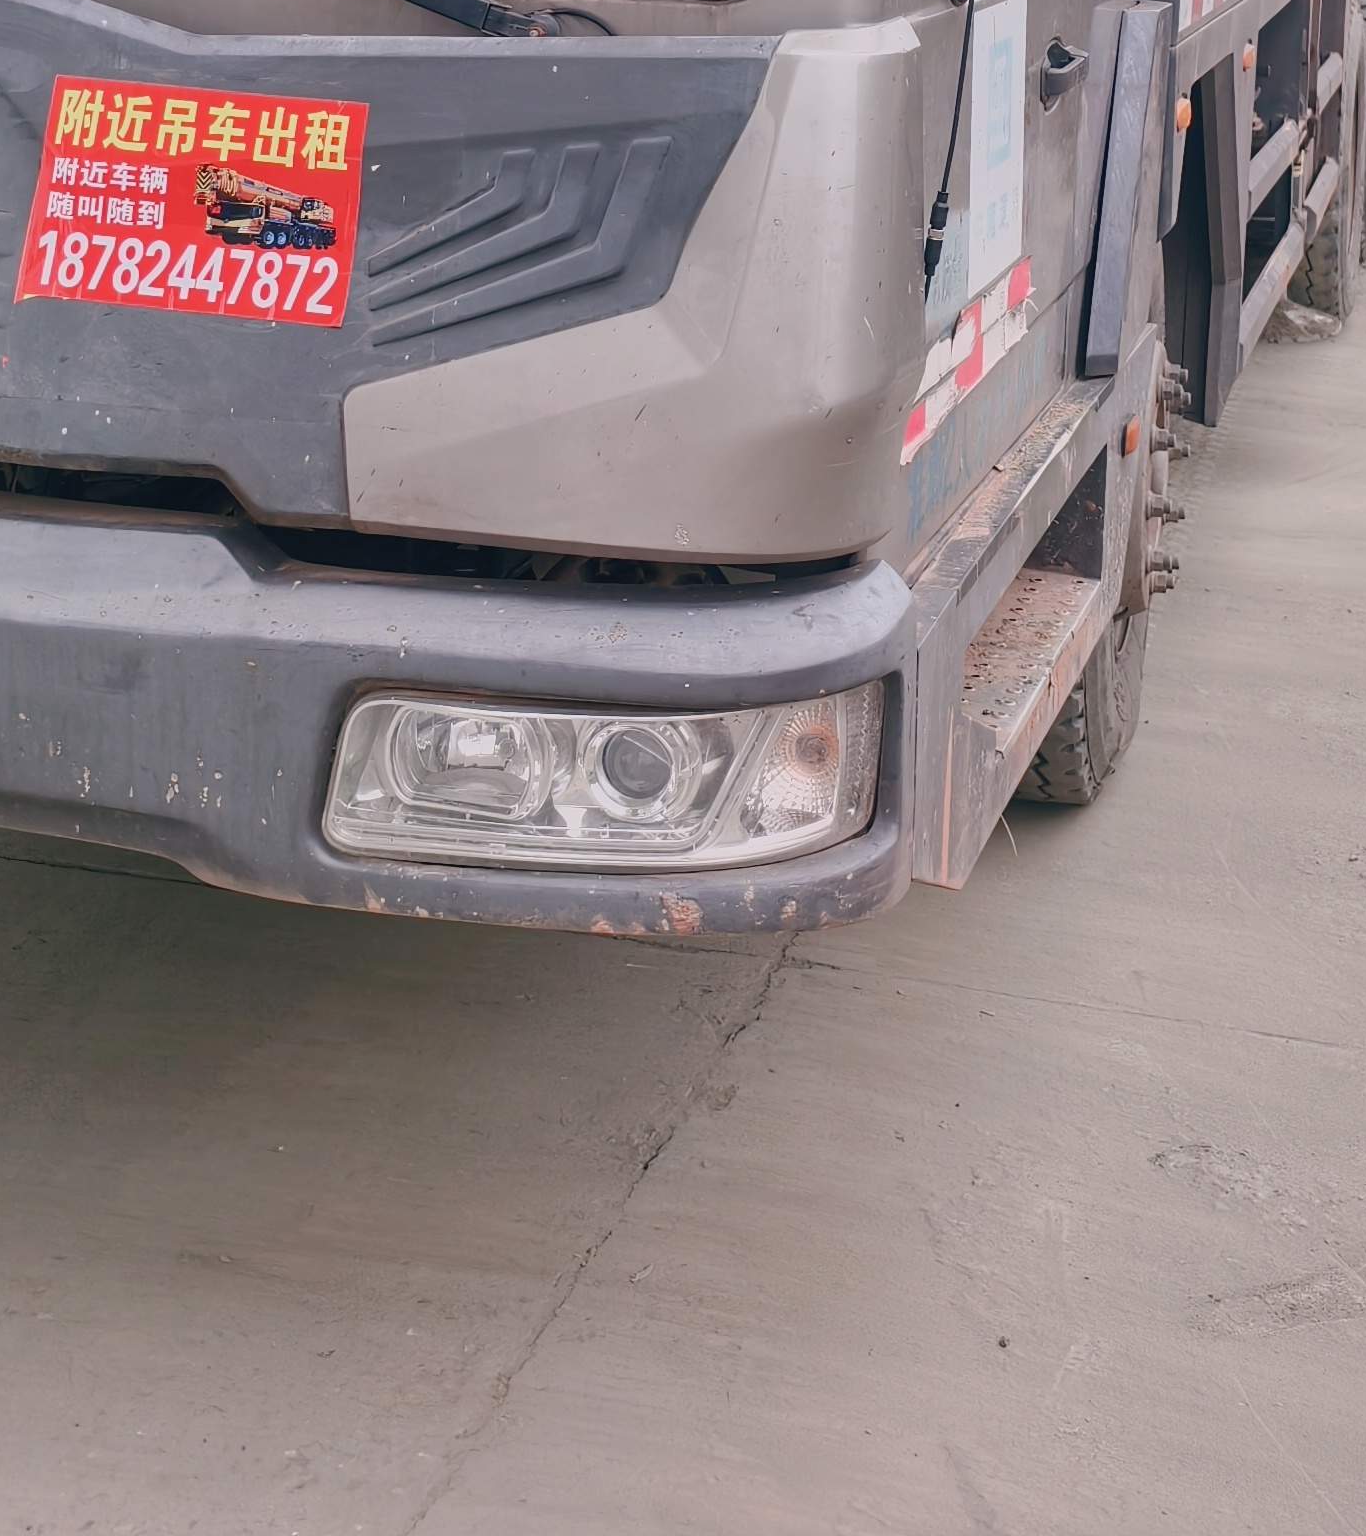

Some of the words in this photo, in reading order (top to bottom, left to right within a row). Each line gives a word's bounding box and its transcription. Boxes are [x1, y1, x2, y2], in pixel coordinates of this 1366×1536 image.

[54, 89, 350, 170] 附近吊车出租
[52, 157, 169, 195] 附近车辆
[46, 192, 167, 230] 随叫随到
[38, 231, 339, 314] 18782447872
